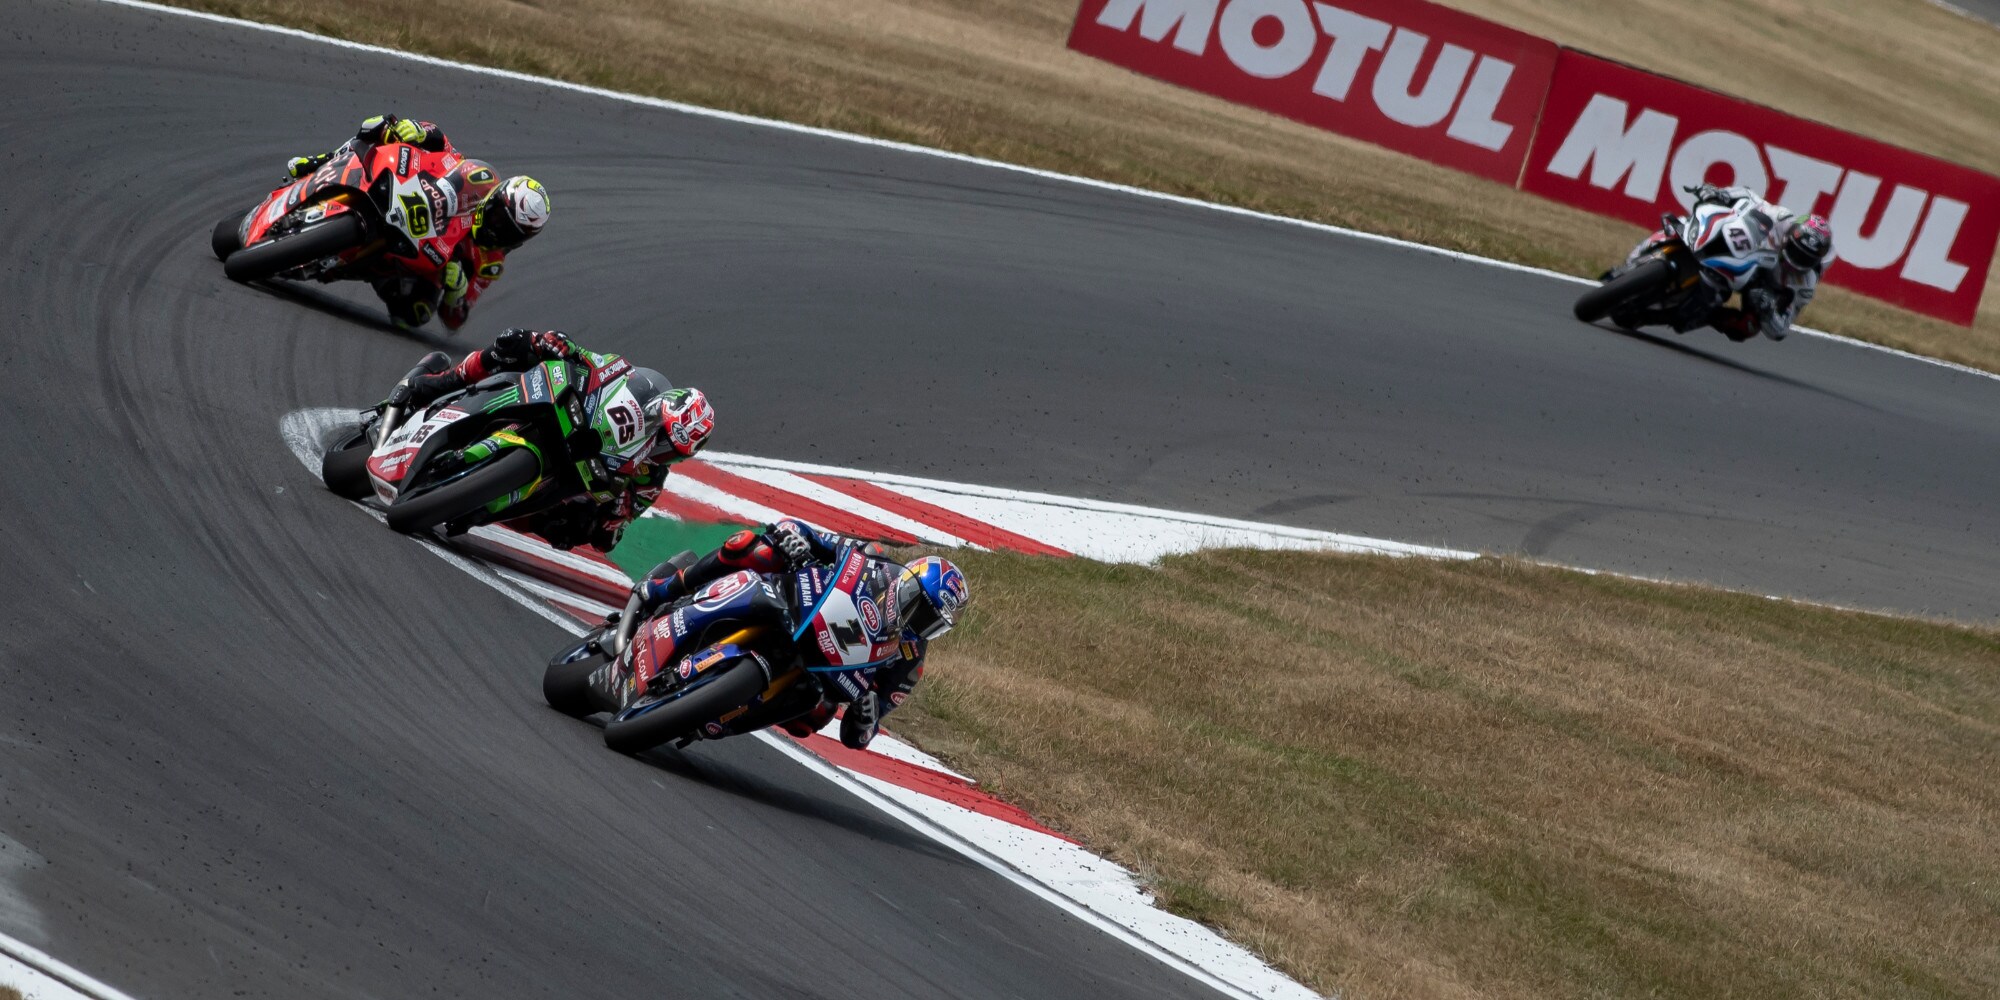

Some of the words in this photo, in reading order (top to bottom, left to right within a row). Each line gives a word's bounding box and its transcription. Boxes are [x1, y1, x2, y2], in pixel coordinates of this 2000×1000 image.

[1097, 0, 1515, 152] MOTUL
[399, 147, 410, 175] Lenovo
[420, 179, 447, 232] aruba.it
[1547, 95, 1970, 294] MOTUL
[397, 191, 430, 239] 19
[1727, 226, 1751, 252] 45
[606, 405, 636, 446] 65
[627, 399, 644, 432] SHOWA
[410, 424, 435, 444] 65
[674, 427, 688, 444] Arai
[798, 573, 814, 607] YAMAHA
[810, 566, 823, 594] McAMS
[863, 604, 877, 626] PATA
[940, 592, 956, 611] SHOEI
[657, 617, 671, 639] BMP
[828, 618, 868, 656] 1
[818, 630, 836, 655] BMP
[837, 671, 861, 700] YAMAHA
